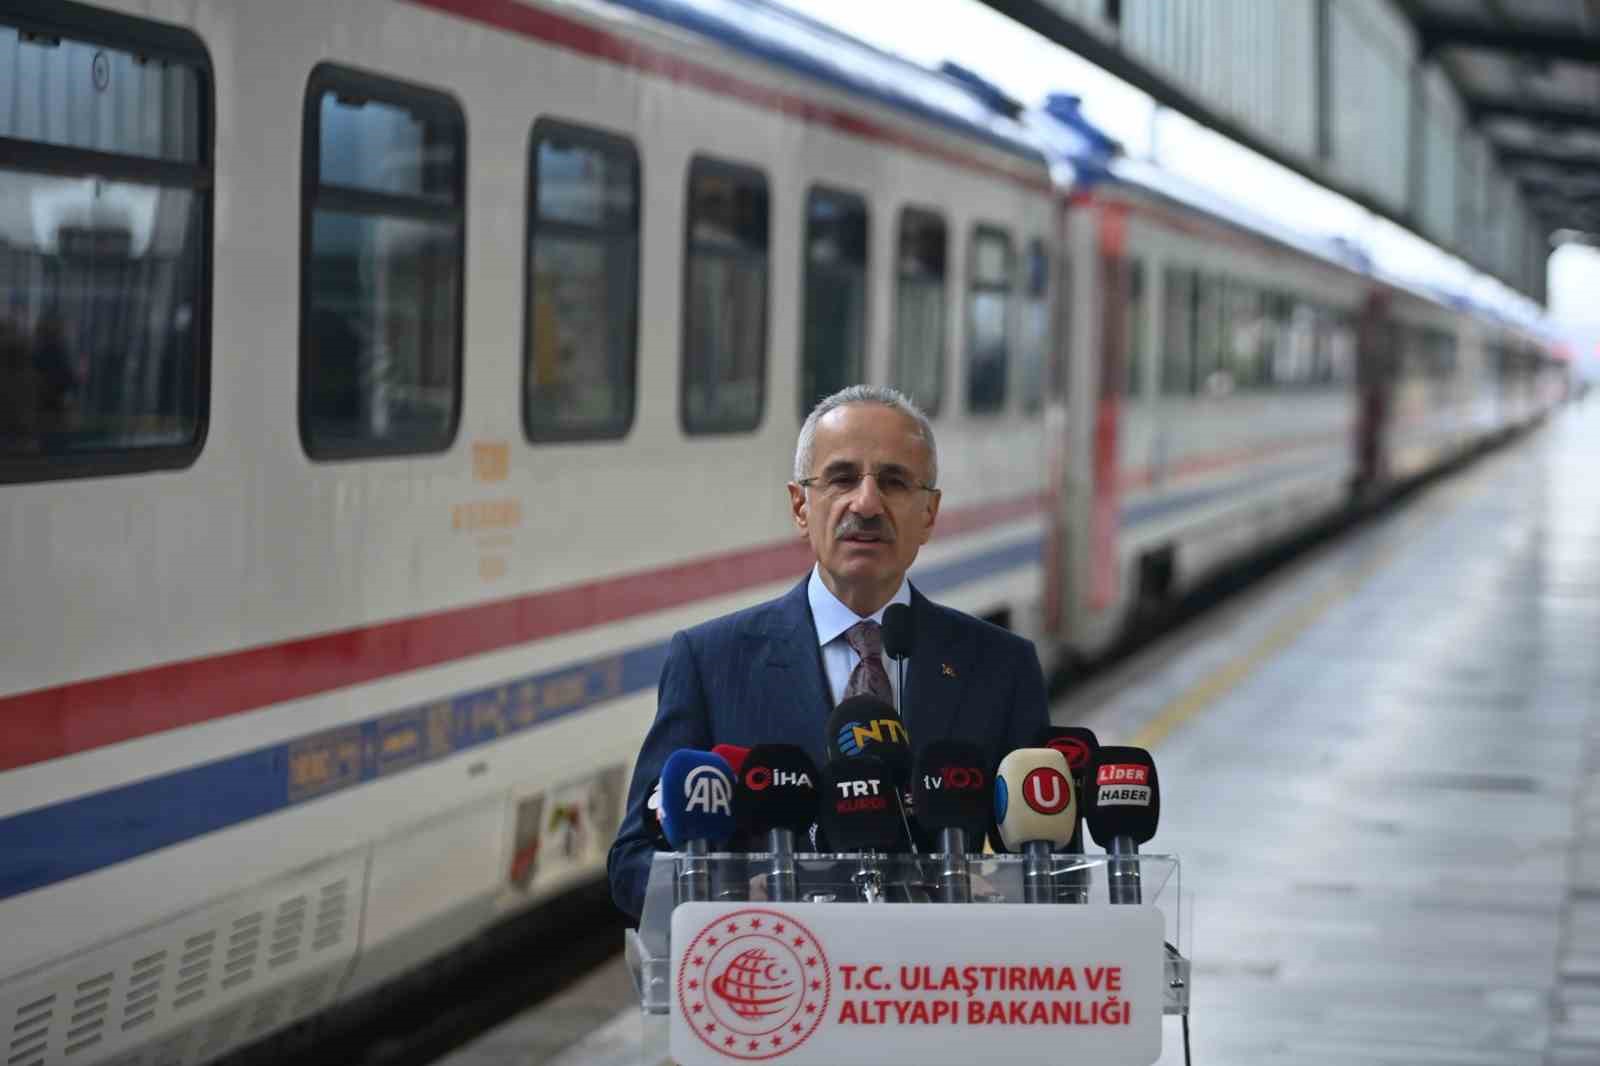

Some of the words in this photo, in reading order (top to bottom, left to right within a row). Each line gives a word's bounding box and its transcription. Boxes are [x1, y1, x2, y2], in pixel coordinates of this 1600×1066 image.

[1099, 765, 1146, 781] LİDER
[836, 779, 880, 798] TRT
[1032, 775, 1060, 808] U
[1100, 787, 1147, 802] HABER
[839, 965, 891, 991] T.C.
[900, 965, 1077, 998] ULAŞTIRMA
[1084, 966, 1122, 991] VE
[838, 1000, 959, 1025] ALTYAPI
[967, 995, 1131, 1025] BAKANLIĞI
